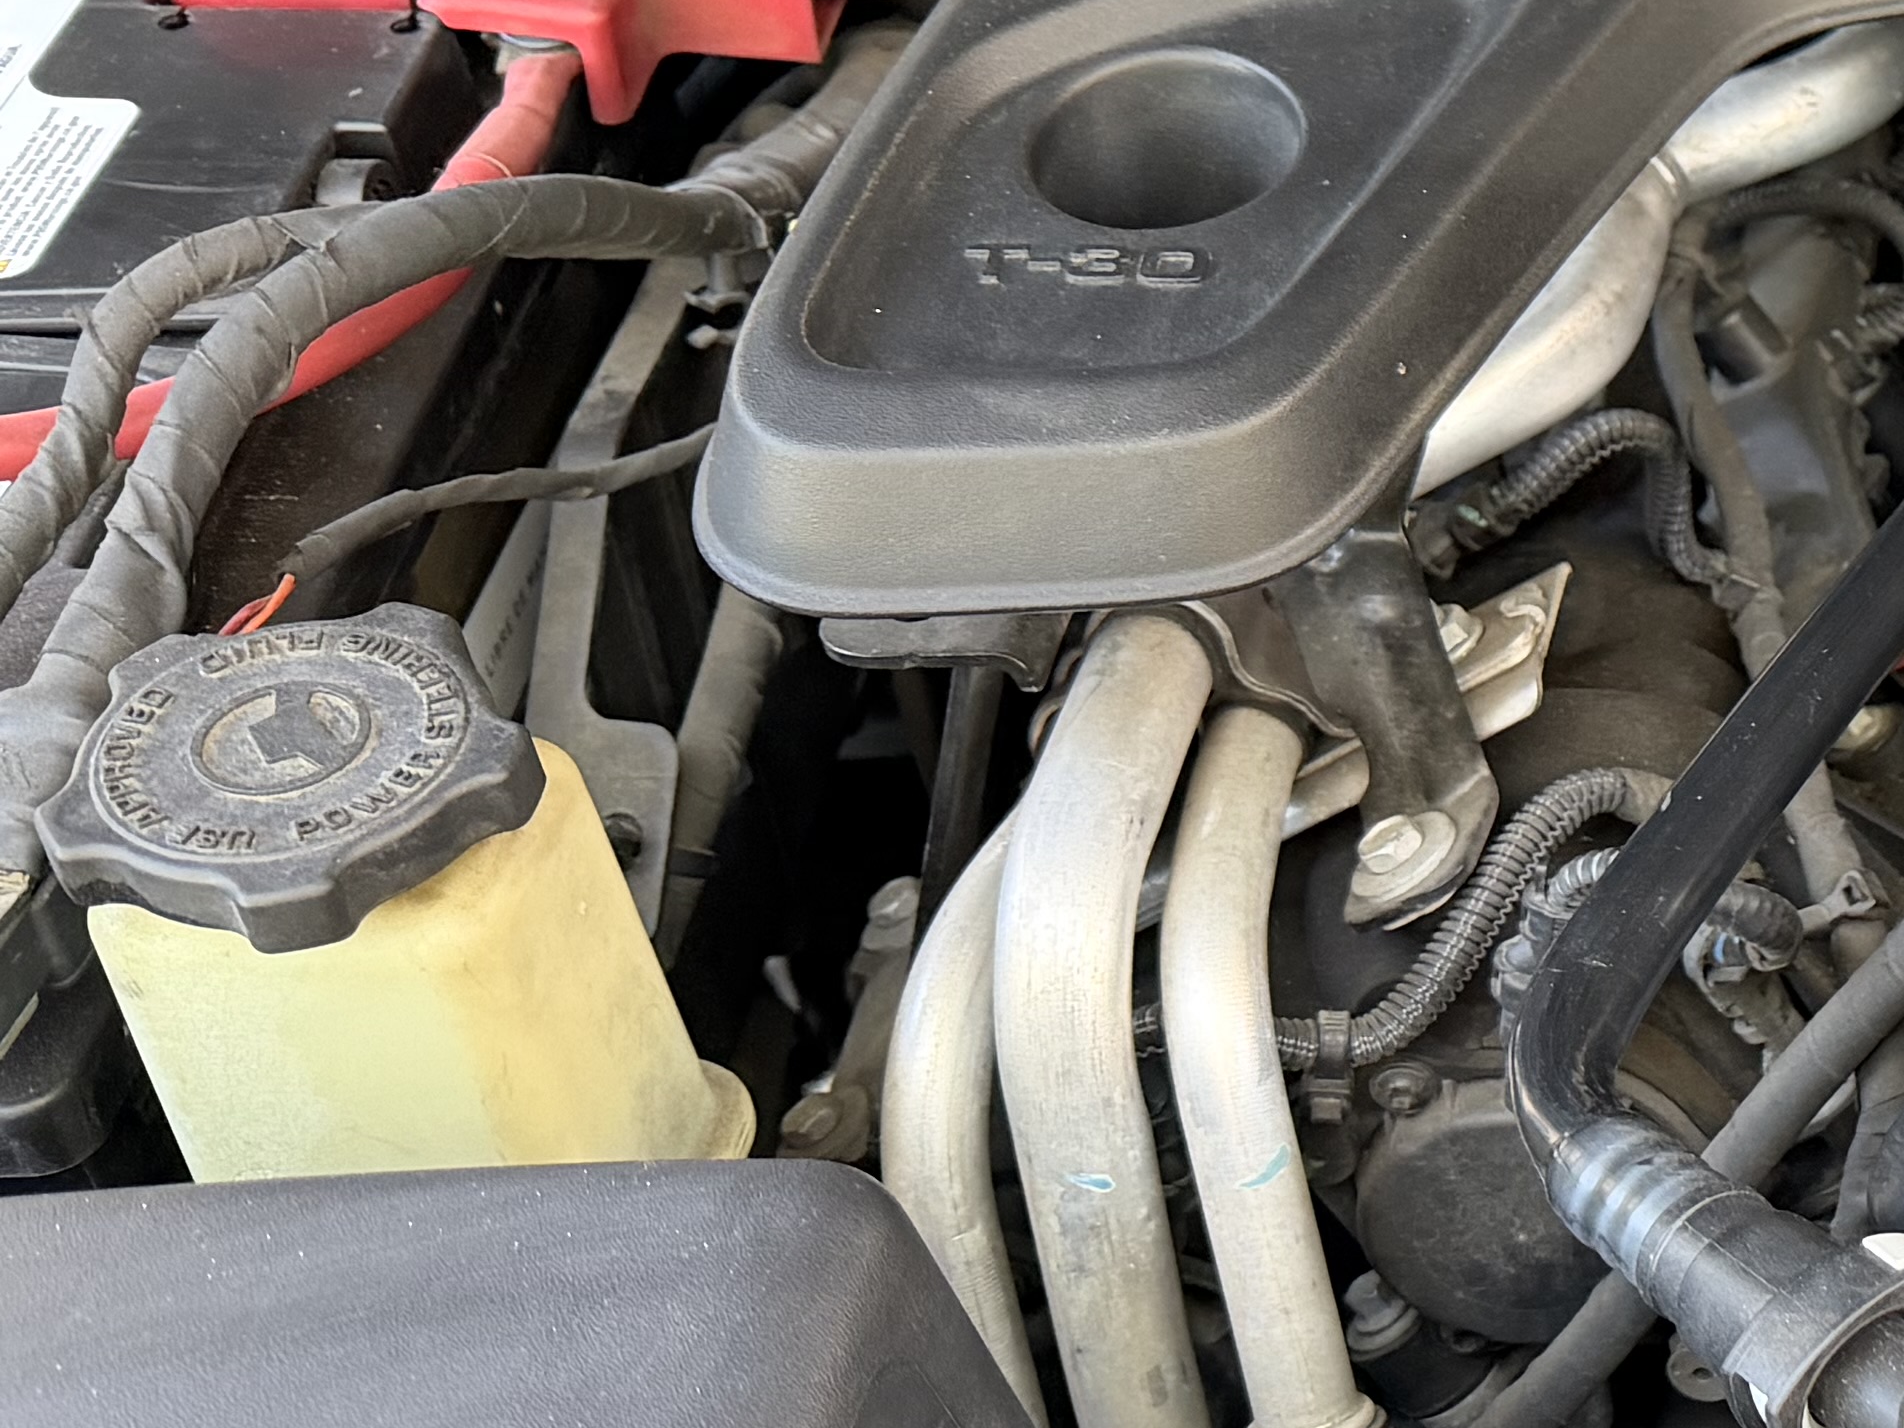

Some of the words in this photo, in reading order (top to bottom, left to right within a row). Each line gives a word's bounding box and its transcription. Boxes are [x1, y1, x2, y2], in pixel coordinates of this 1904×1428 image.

[962, 244, 1212, 289] T-30
[198, 627, 326, 676] FLUID
[341, 629, 457, 742] STEERING
[101, 686, 176, 832] APPROVED
[294, 750, 440, 843] POWER
